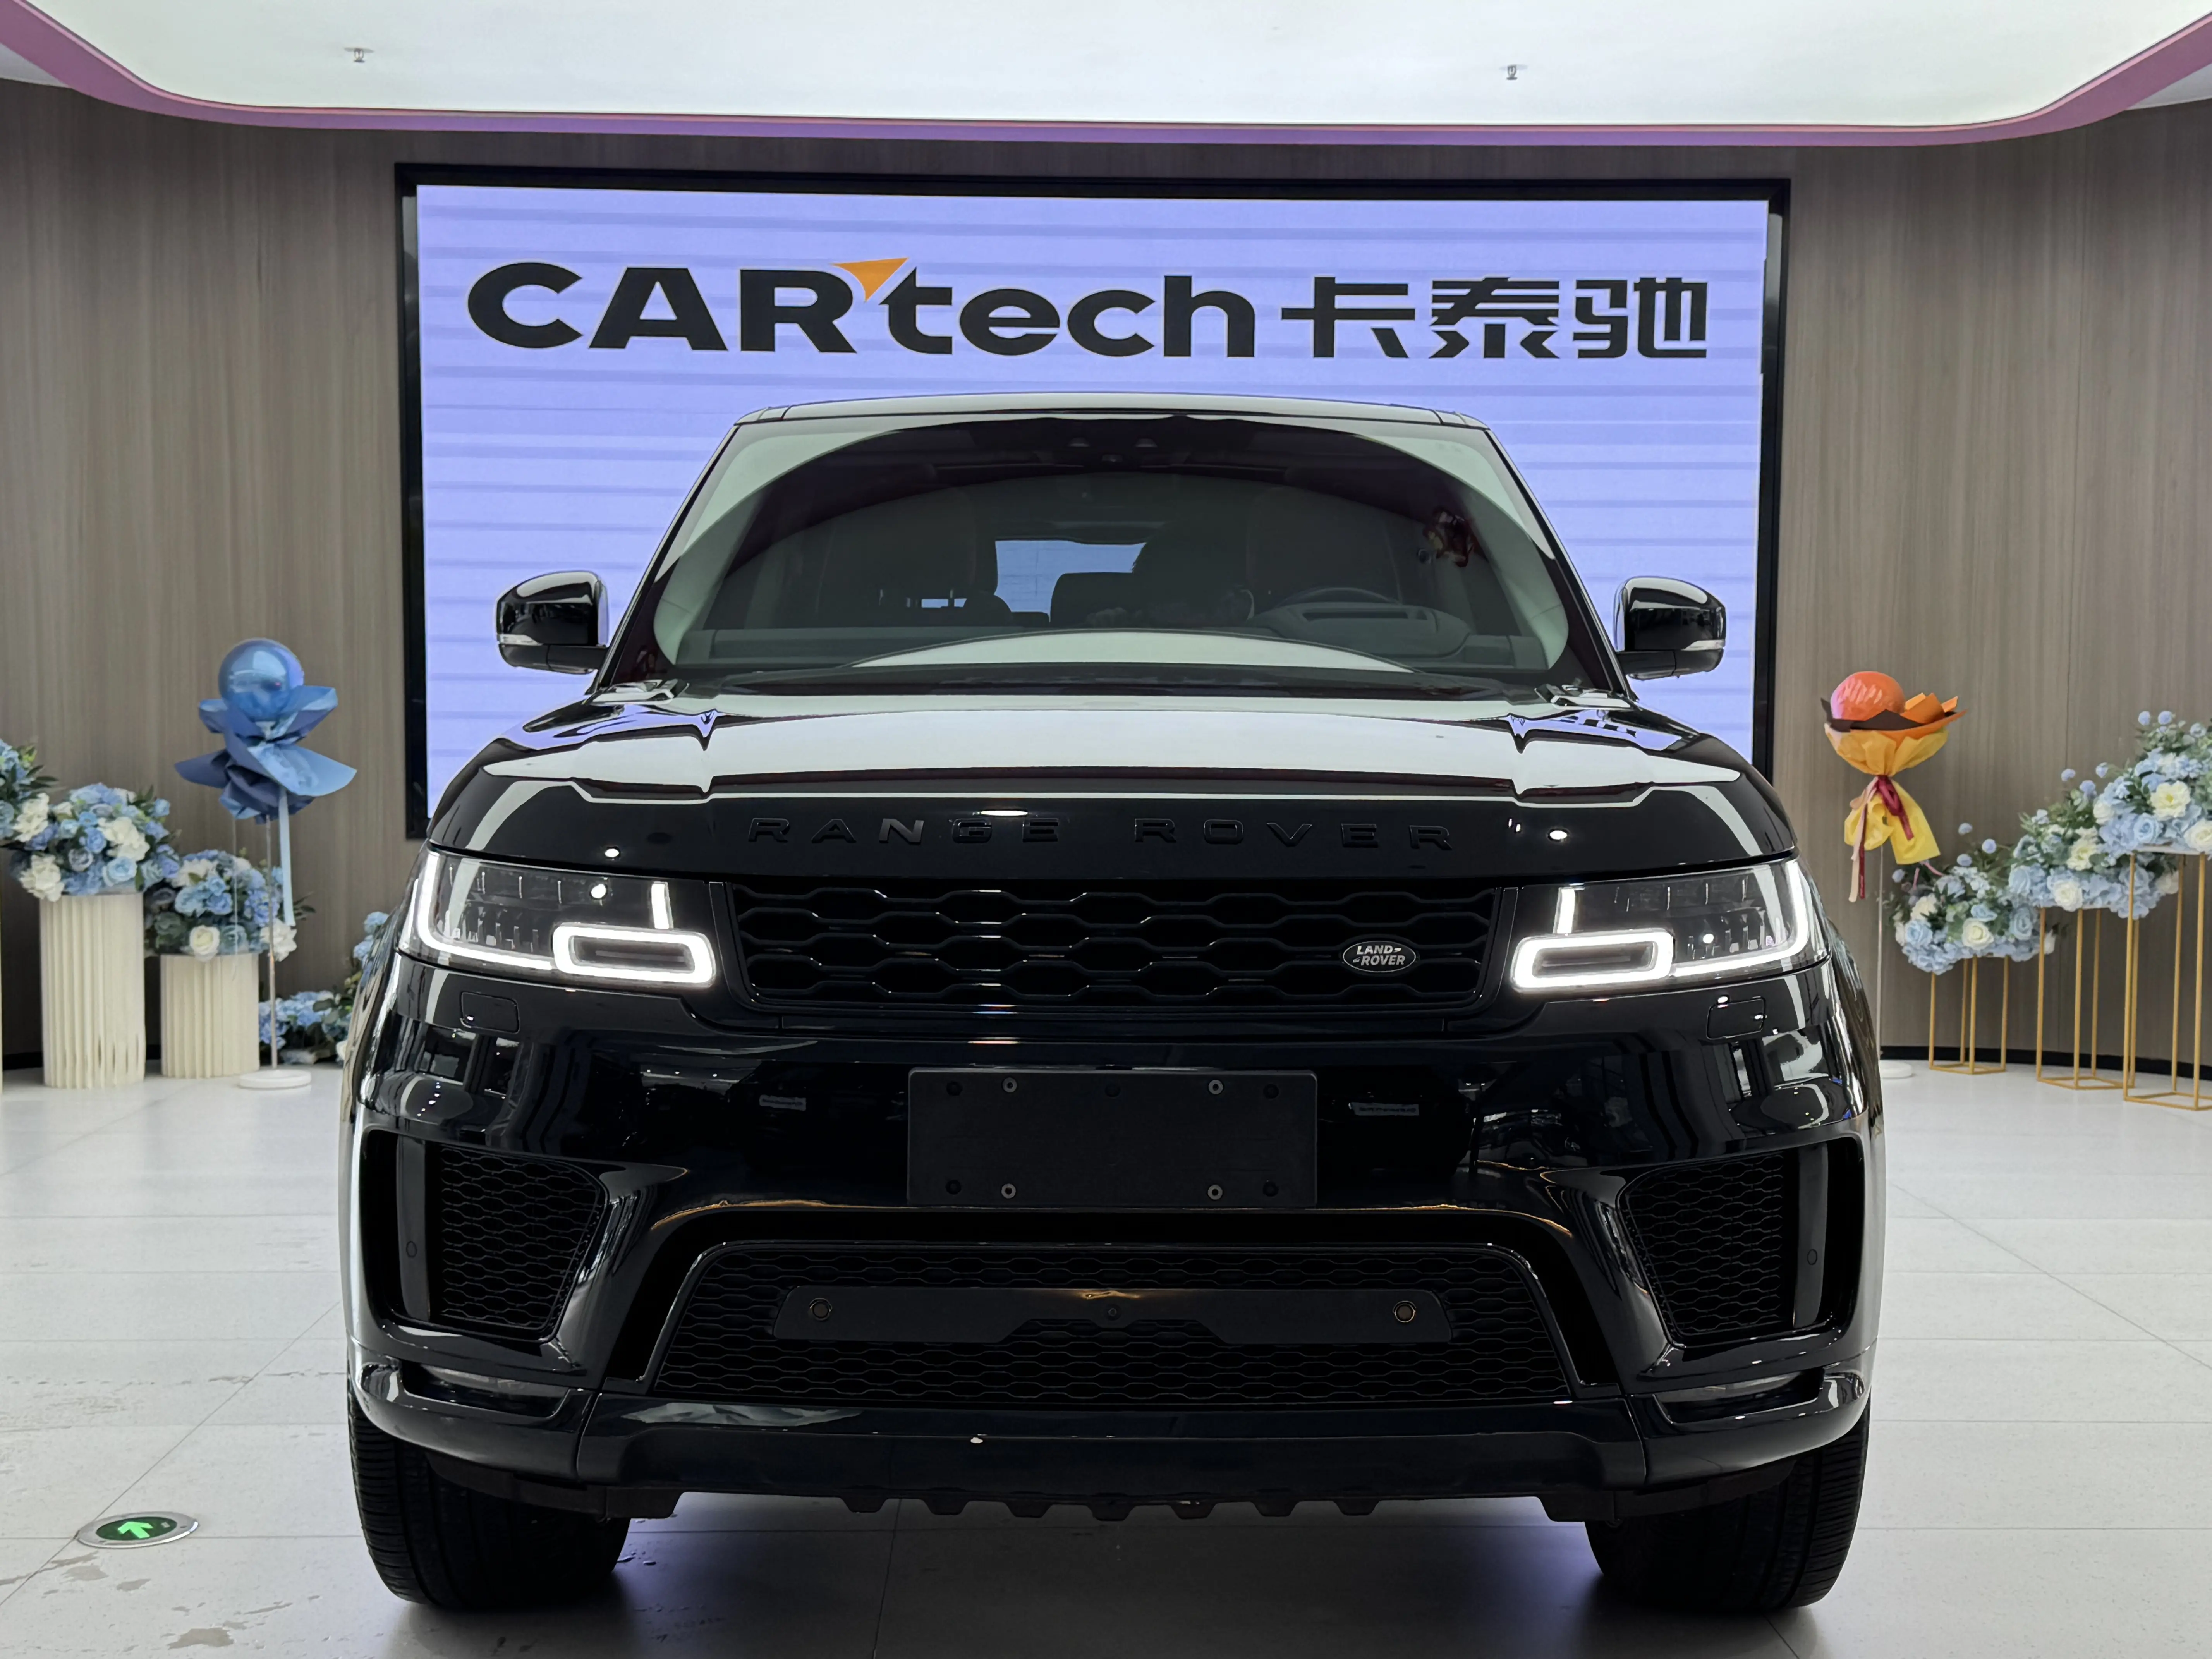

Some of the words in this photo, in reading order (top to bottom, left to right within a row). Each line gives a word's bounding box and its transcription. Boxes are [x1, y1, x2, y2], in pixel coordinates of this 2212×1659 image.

[467, 262, 1255, 357] CARtech
[1281, 276, 1708, 359] 卡泰驰
[747, 817, 1060, 843] RANGE
[1134, 818, 1452, 850] ROVER
[1357, 945, 1393, 955] LAND
[1361, 955, 1405, 965] ROVER
